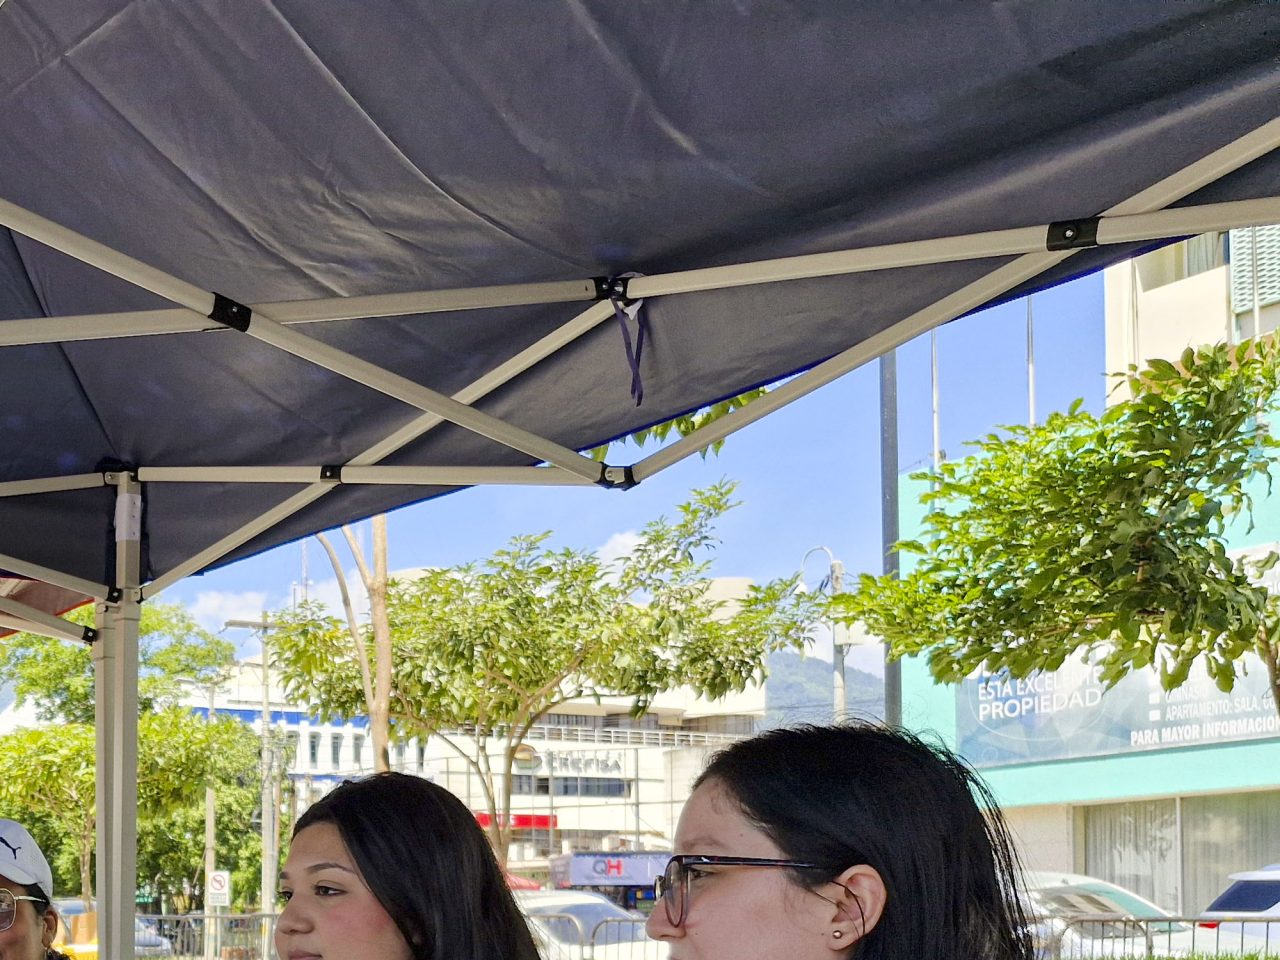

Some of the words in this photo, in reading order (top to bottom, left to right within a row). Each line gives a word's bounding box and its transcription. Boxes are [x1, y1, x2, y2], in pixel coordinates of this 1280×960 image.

[978, 680, 1013, 701] ESTA
[978, 688, 1102, 722] PROPIEDAD
[1130, 728, 1160, 747] PARA
[1161, 724, 1200, 744] MAYOR
